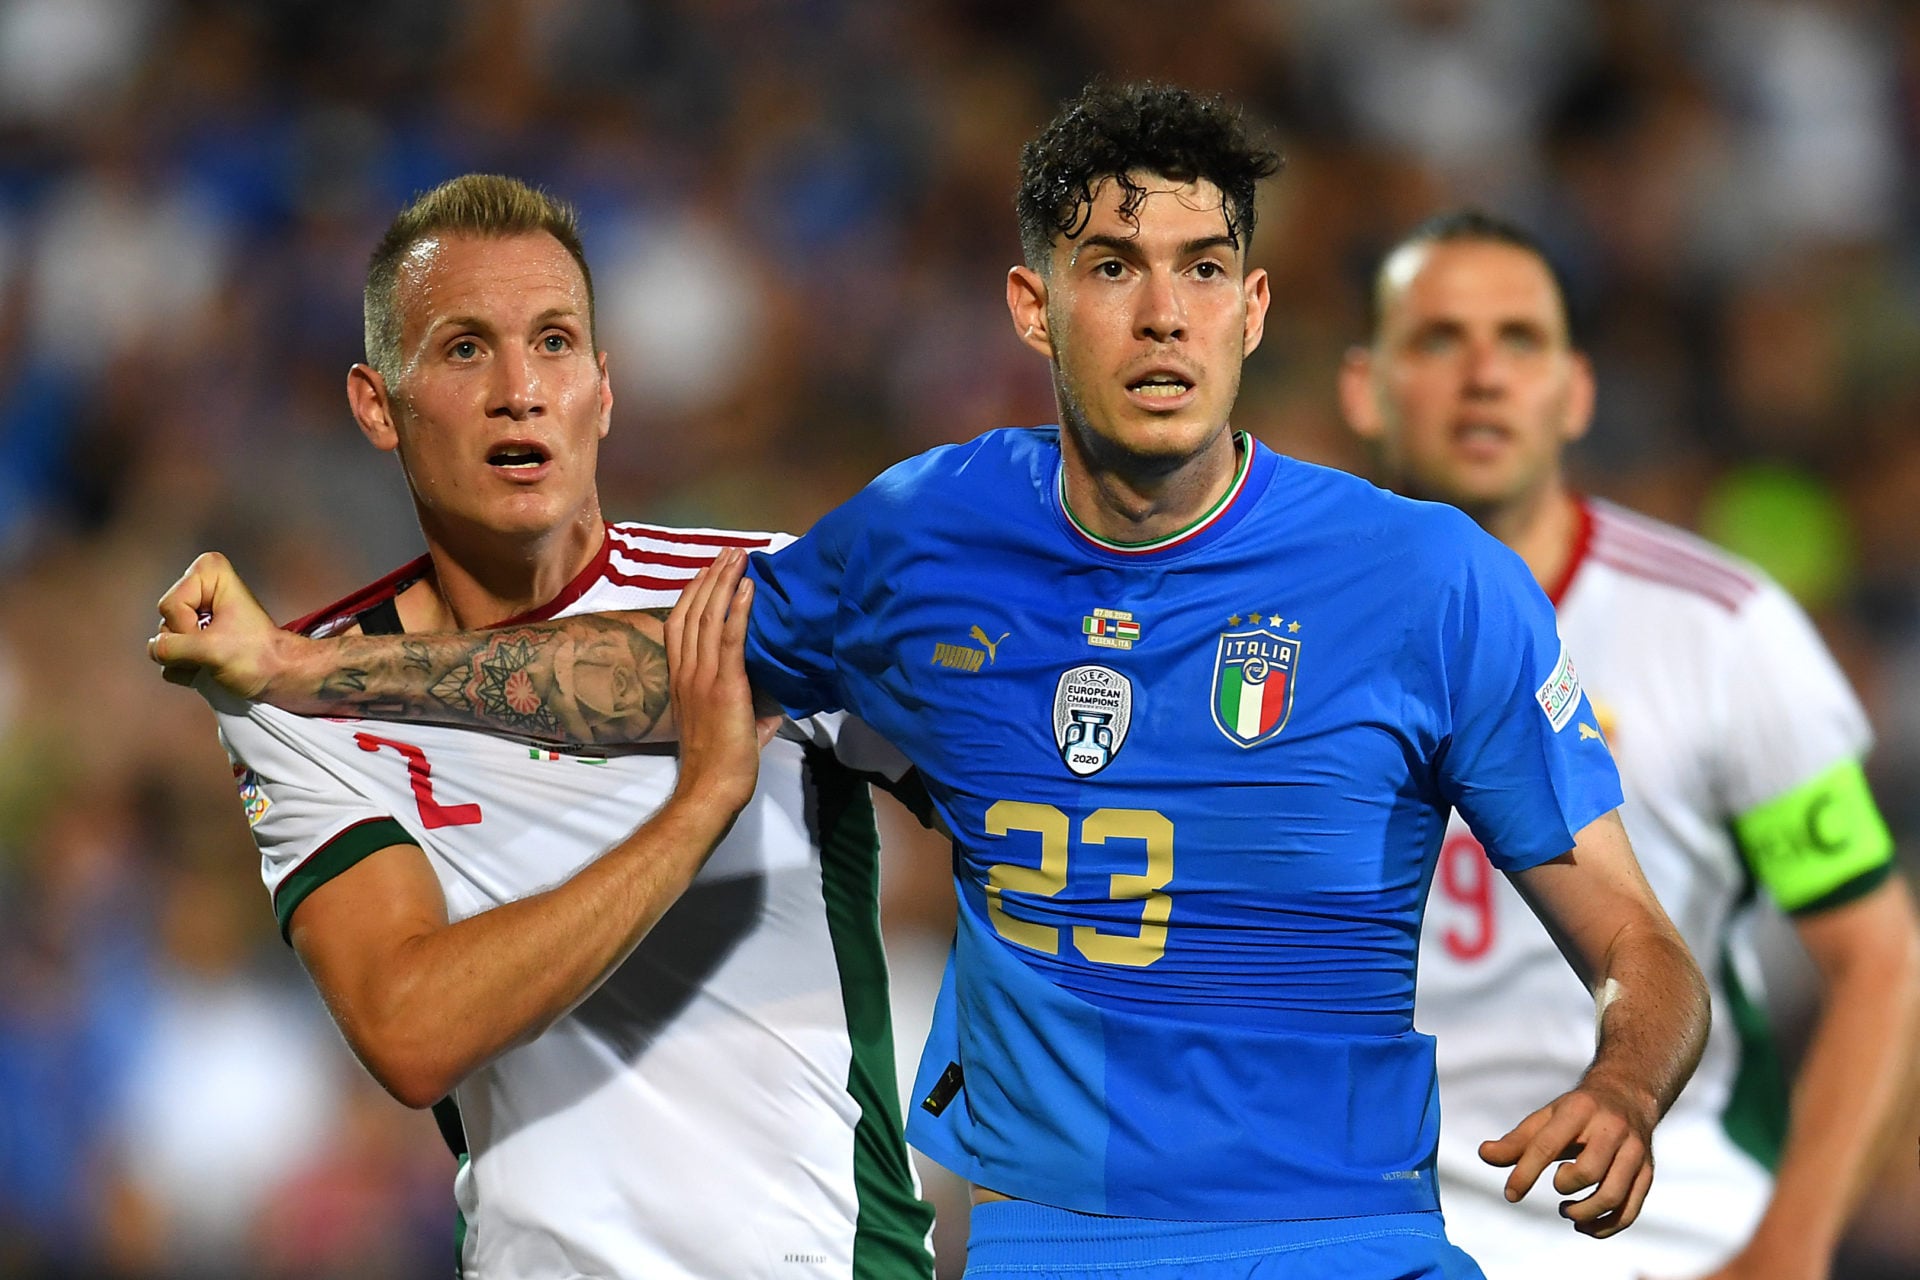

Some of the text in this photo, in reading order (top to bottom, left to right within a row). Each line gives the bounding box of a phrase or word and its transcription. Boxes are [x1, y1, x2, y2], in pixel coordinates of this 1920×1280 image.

[931, 643, 986, 673] PUMA
[1226, 641, 1291, 662] ITALIA
[1080, 671, 1110, 685] UEFA
[1066, 695, 1119, 708] CHAMPIONS
[1067, 685, 1121, 699] EUROPEAN
[1072, 754, 1099, 765] 2020
[353, 731, 482, 829] 2
[985, 799, 1174, 967] 23
[1441, 833, 1495, 964] 9
